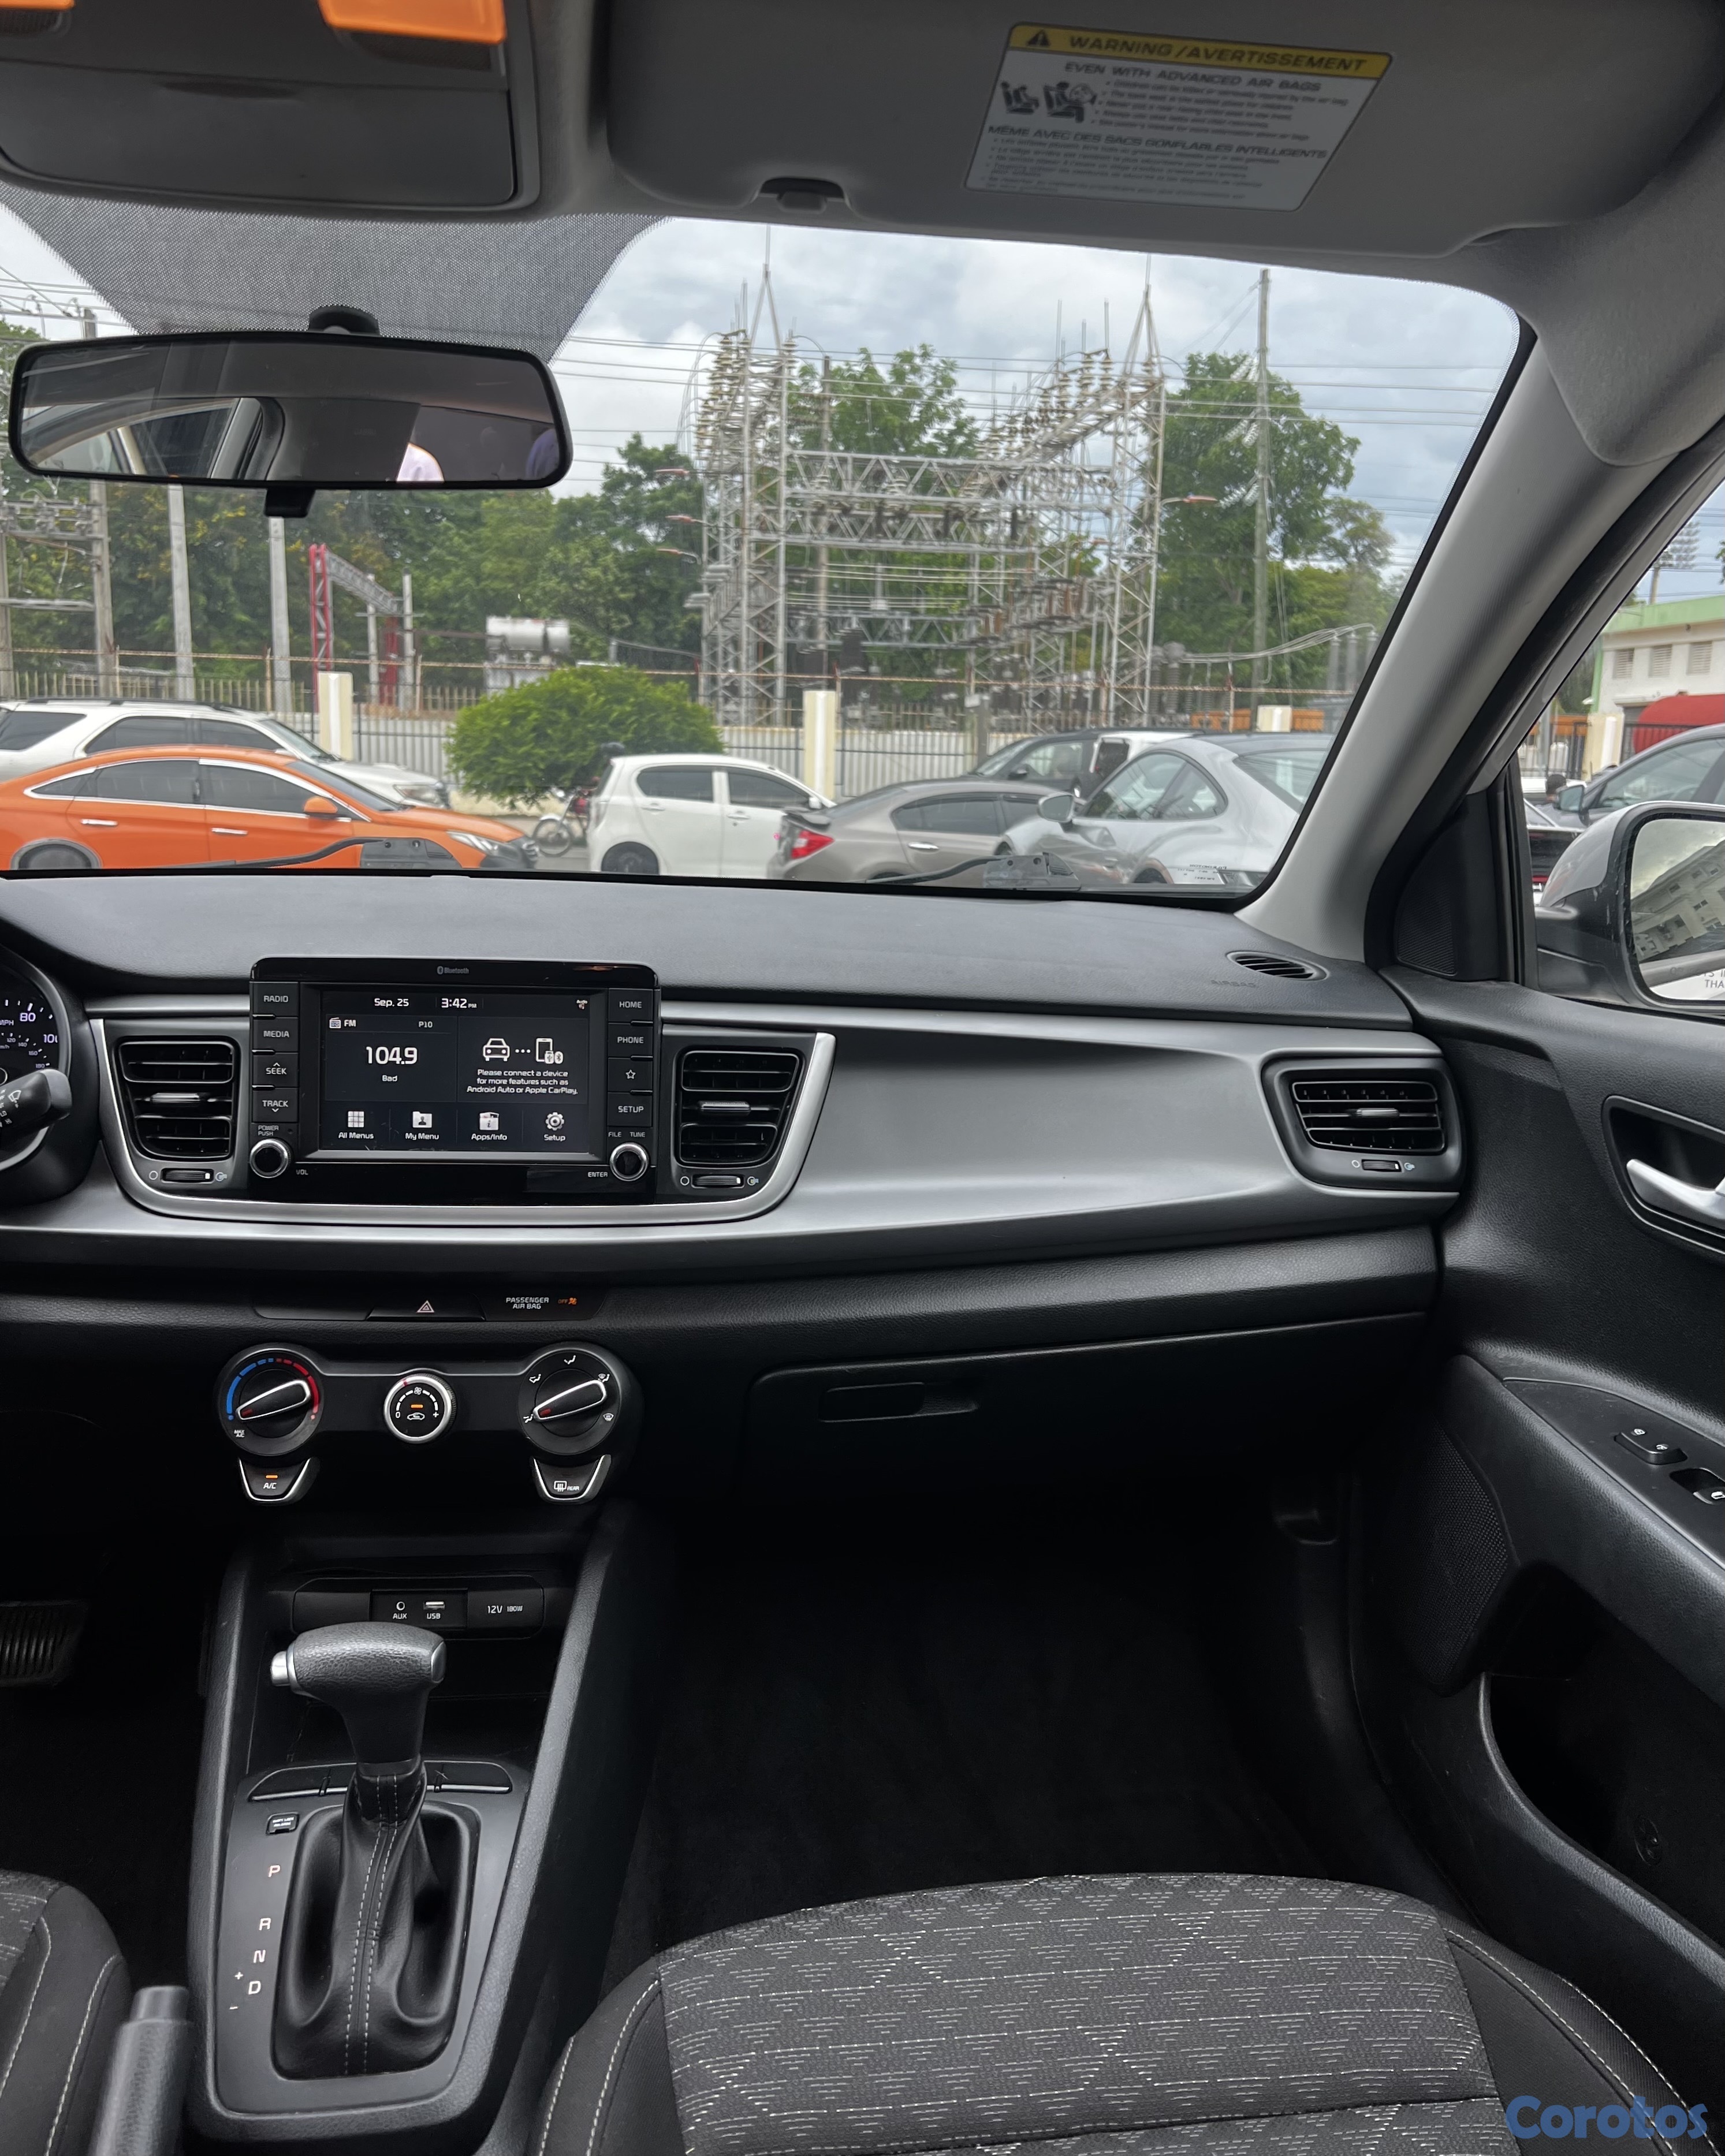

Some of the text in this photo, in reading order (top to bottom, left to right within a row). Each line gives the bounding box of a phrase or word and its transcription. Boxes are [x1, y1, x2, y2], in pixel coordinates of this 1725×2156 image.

[1065, 61, 1322, 92] EVEN WITH ADVANCED AIR BAGS
[1032, 129, 1070, 141] AVEC
[1073, 131, 1101, 143] DES
[1104, 134, 1143, 147] SACS
[374, 998, 409, 1008] Sep. 25
[619, 1001, 642, 1009] HOME
[20, 1012, 36, 1022] 80
[344, 1019, 356, 1027] FM
[366, 1046, 418, 1065] 104.9
[618, 1105, 644, 1113] SETUP
[471, 1133, 508, 1141] Apps/Info
[543, 1134, 566, 1142] Setup
[487, 1605, 503, 1614] 12V
[267, 1864, 281, 1878] P
[259, 1918, 271, 1931] R
[253, 1949, 266, 1963] N
[248, 1980, 261, 1995] D
